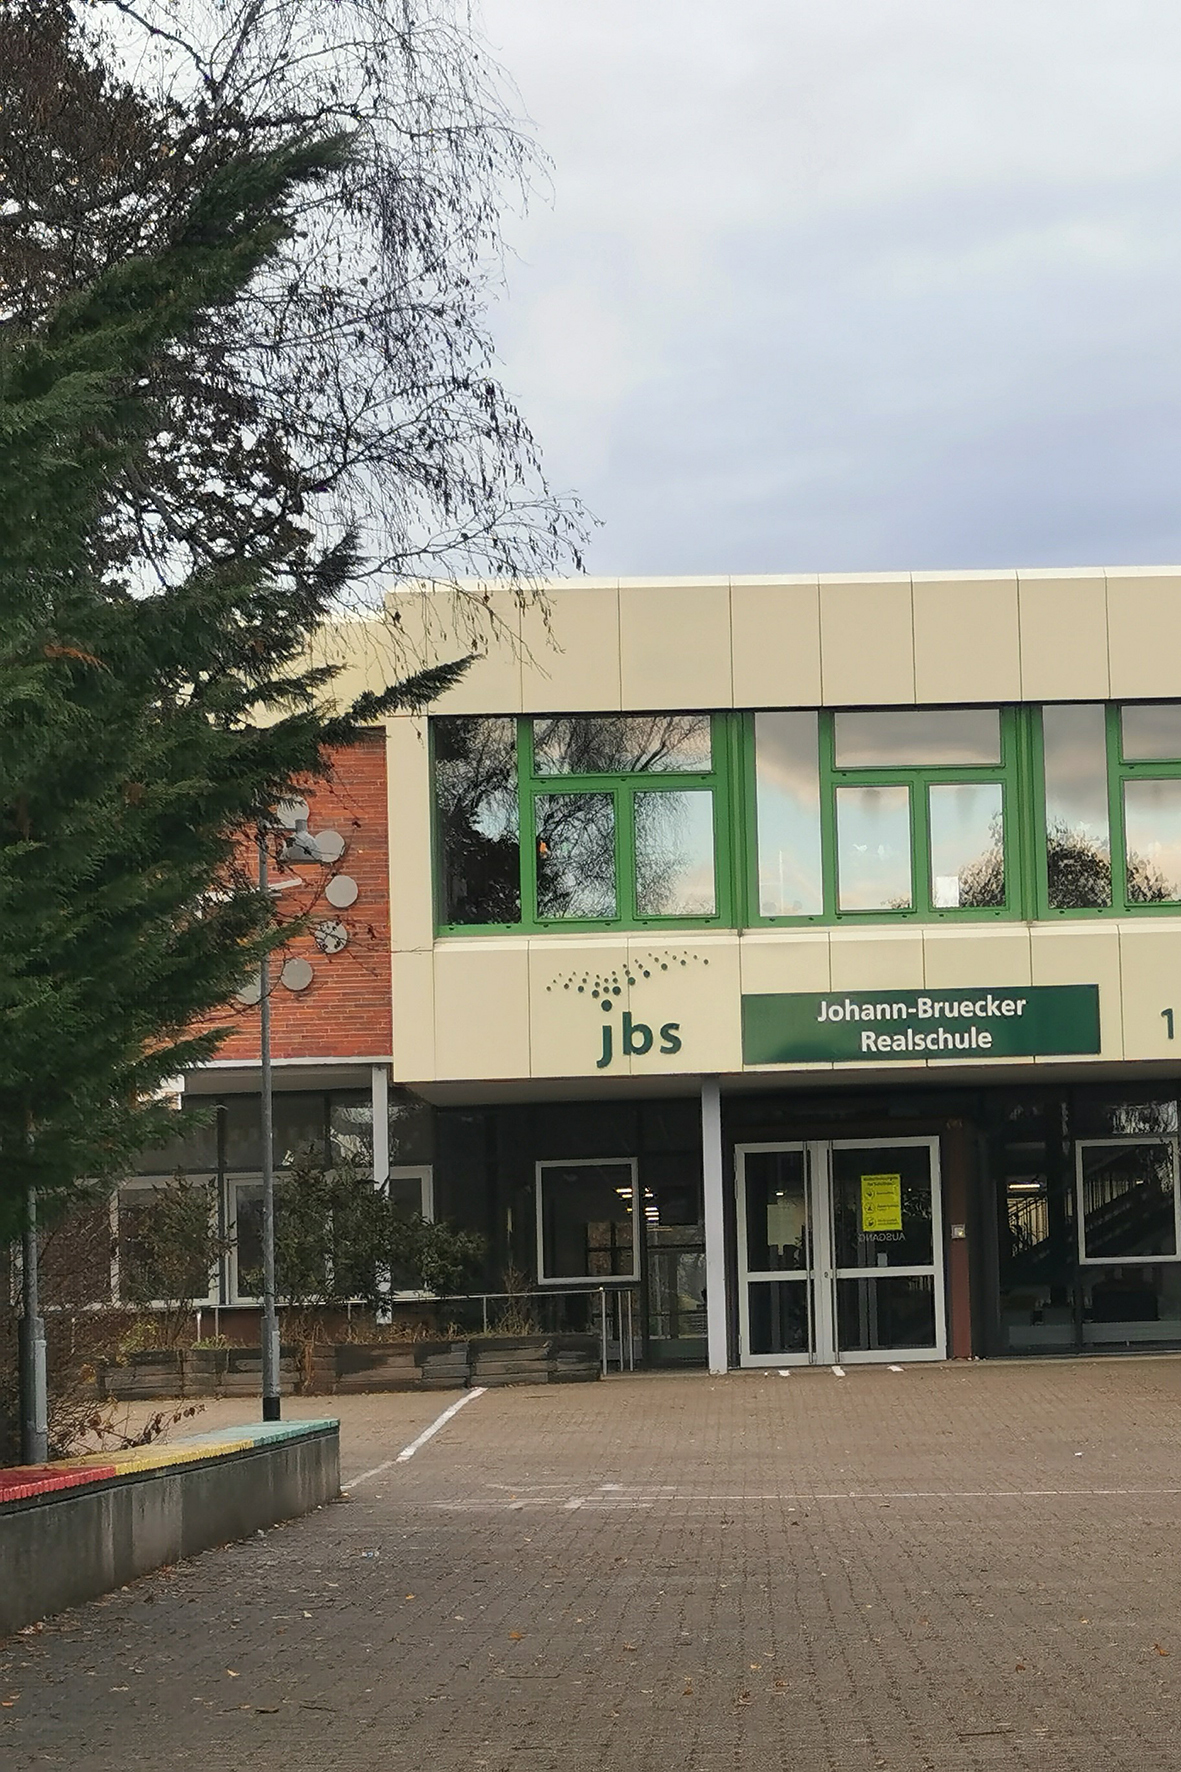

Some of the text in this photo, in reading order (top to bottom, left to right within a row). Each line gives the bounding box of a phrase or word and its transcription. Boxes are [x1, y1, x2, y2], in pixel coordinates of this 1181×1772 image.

[817, 995, 1027, 1022] Johann-Bruecker
[596, 999, 682, 1068] jbs
[861, 1026, 993, 1053] Realschule
